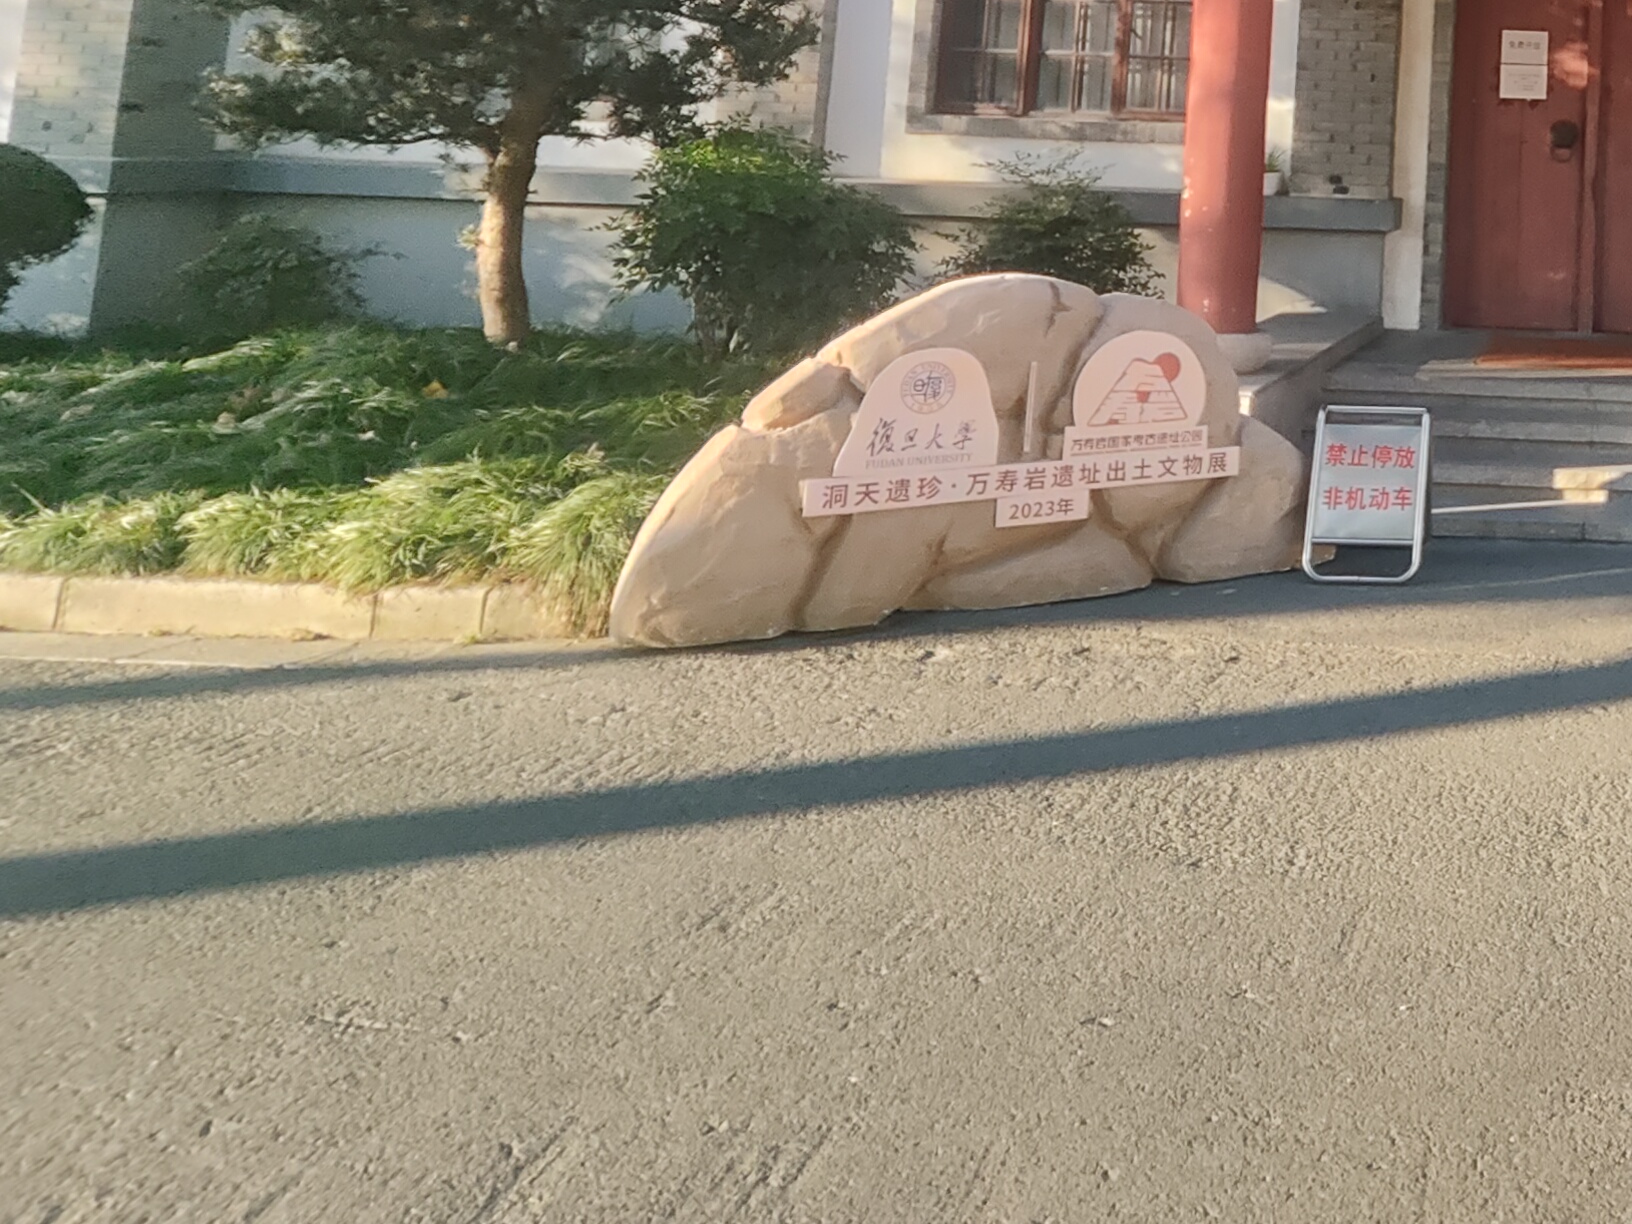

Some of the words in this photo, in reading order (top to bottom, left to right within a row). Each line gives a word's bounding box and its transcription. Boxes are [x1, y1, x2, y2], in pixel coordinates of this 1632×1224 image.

[865, 458, 904, 470] FUDAN
[907, 452, 973, 465] UNIVERSITY
[1325, 443, 1416, 469] 禁止停放
[1008, 497, 1075, 521] 2023年
[1322, 486, 1413, 511] 非机动车
